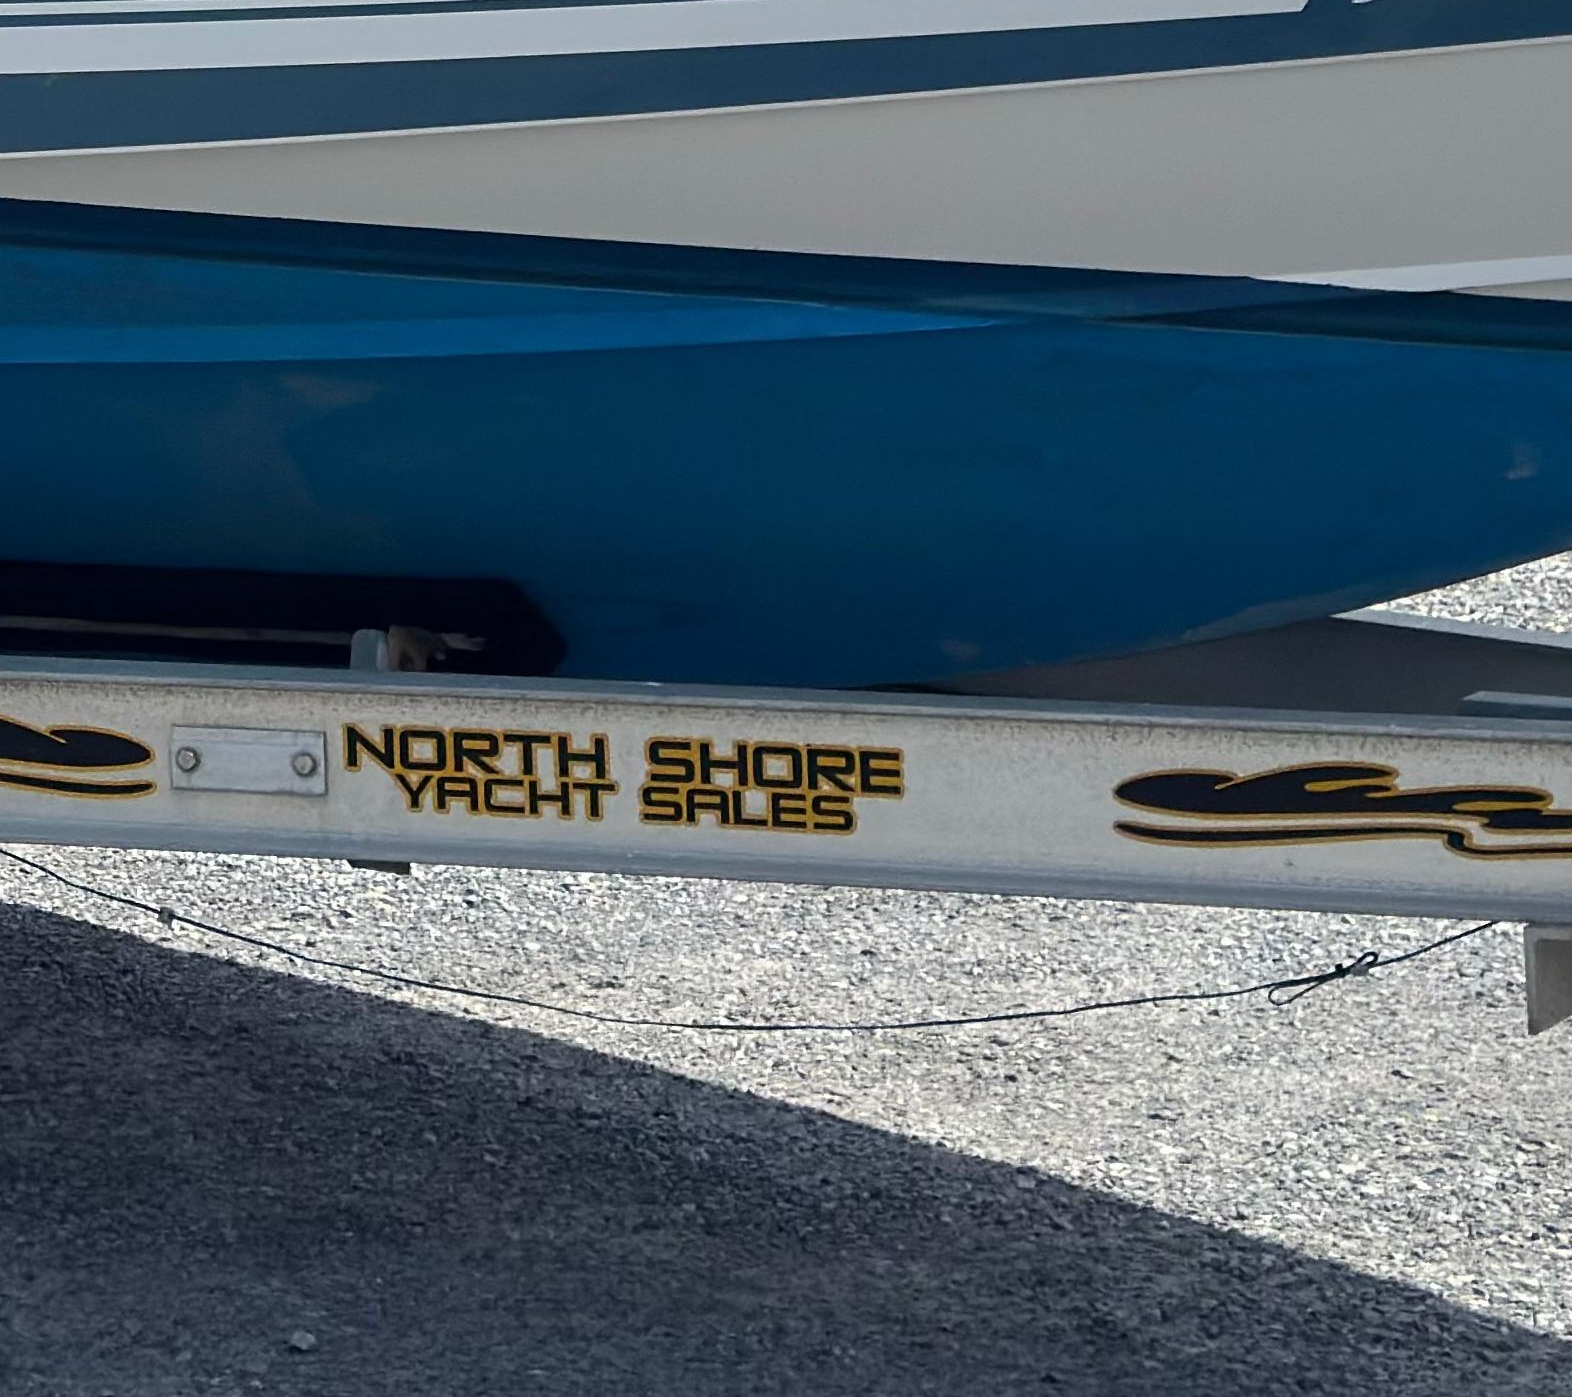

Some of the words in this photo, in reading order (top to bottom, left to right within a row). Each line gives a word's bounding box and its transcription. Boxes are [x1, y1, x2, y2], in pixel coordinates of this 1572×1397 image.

[343, 722, 611, 783] NORTH
[643, 735, 905, 799] SHORE
[394, 772, 619, 821] YACHT
[638, 782, 858, 834] SALES
